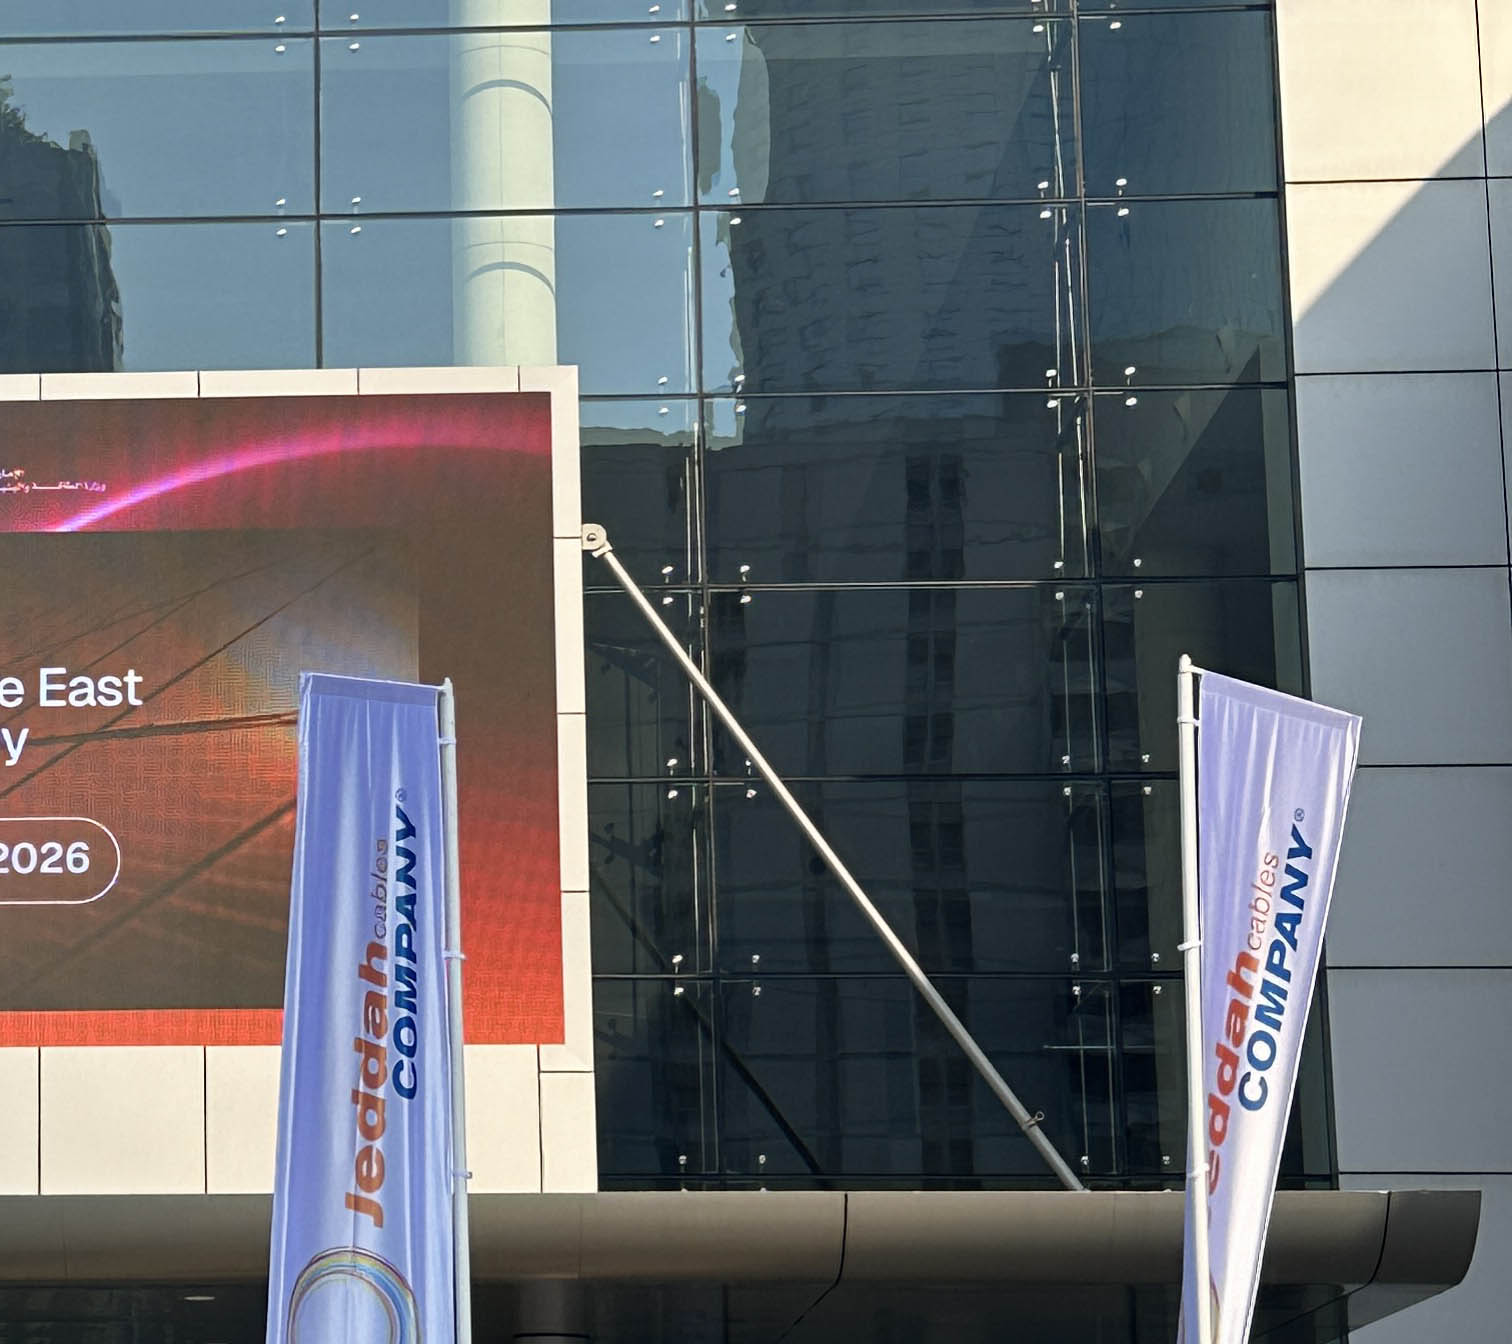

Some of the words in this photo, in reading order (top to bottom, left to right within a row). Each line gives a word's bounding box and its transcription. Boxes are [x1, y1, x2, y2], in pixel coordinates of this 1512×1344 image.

[38, 666, 144, 708] East
[1248, 852, 1280, 951] cables
[345, 941, 389, 1230] Jeddah
